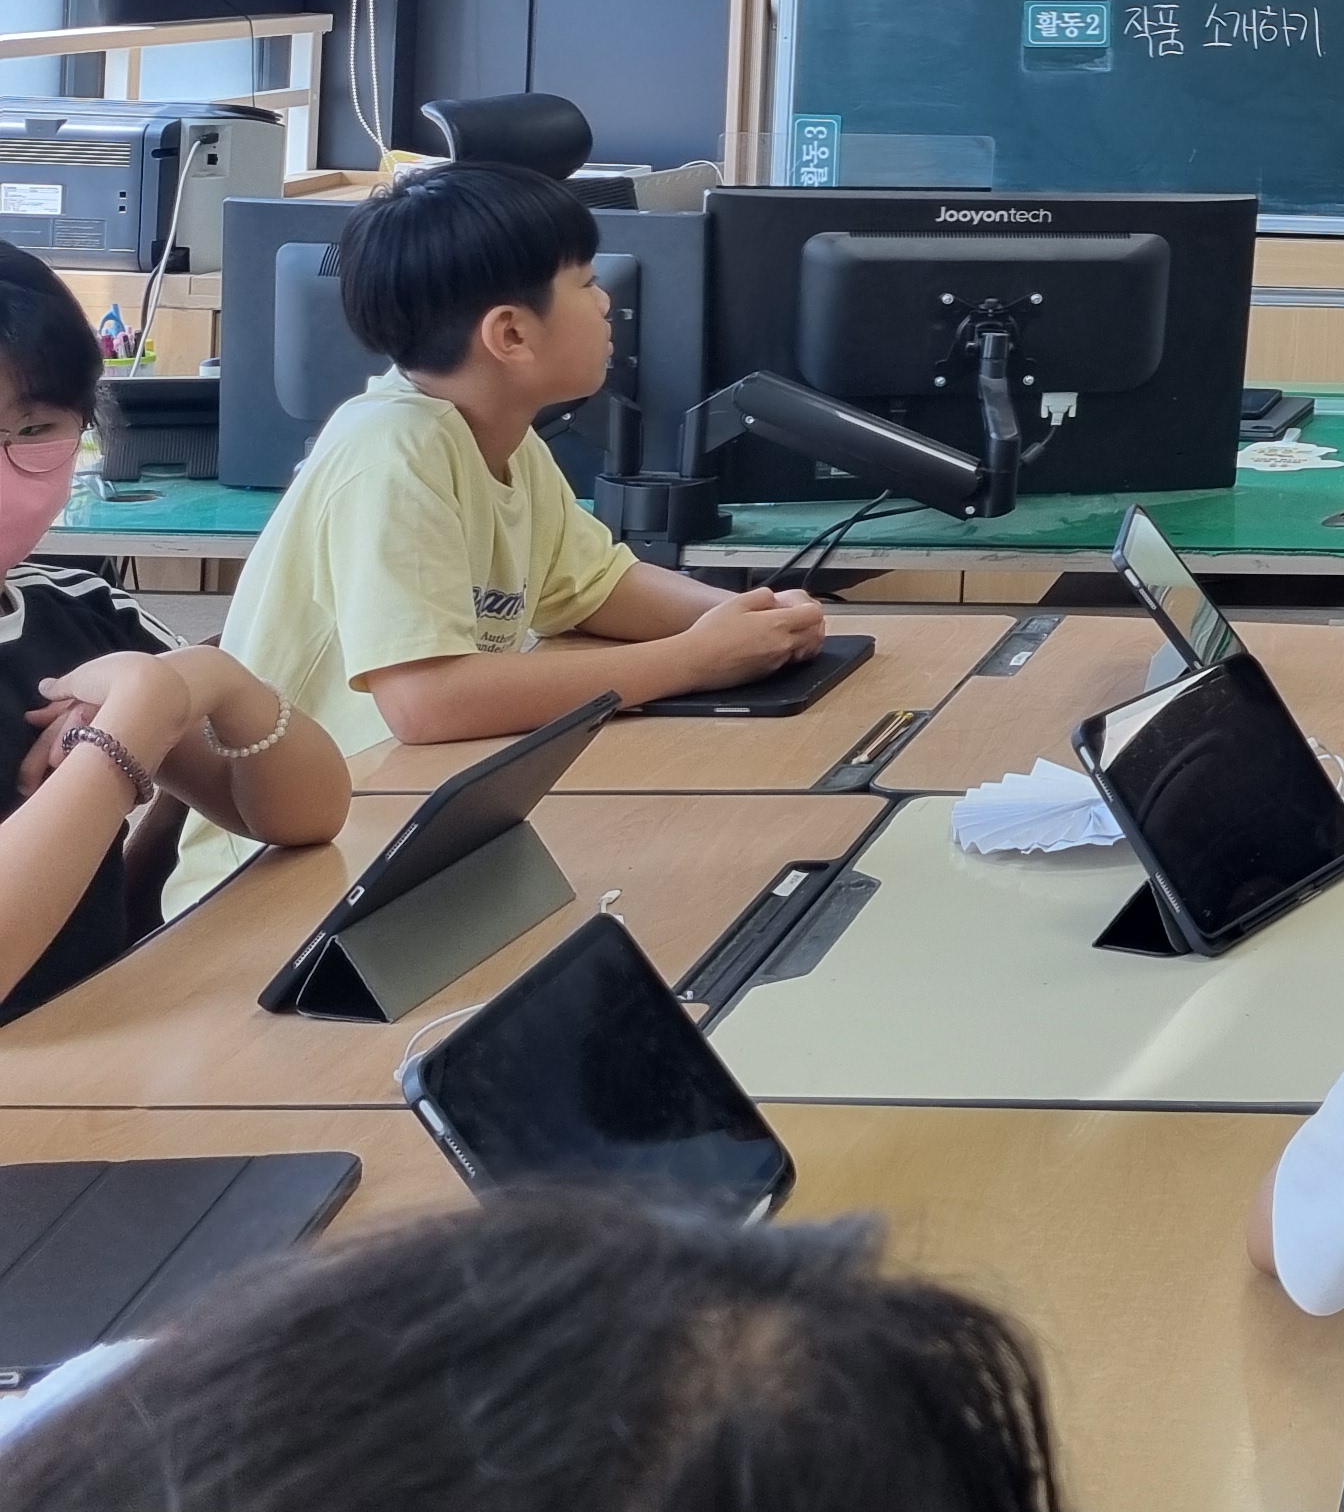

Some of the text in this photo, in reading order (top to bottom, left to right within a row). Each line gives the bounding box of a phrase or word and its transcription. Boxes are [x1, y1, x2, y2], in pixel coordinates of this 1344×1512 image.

[1035, 11, 1100, 38] 활동2
[1124, 4, 1184, 58] 작품
[935, 207, 1052, 225] Jooyontech
